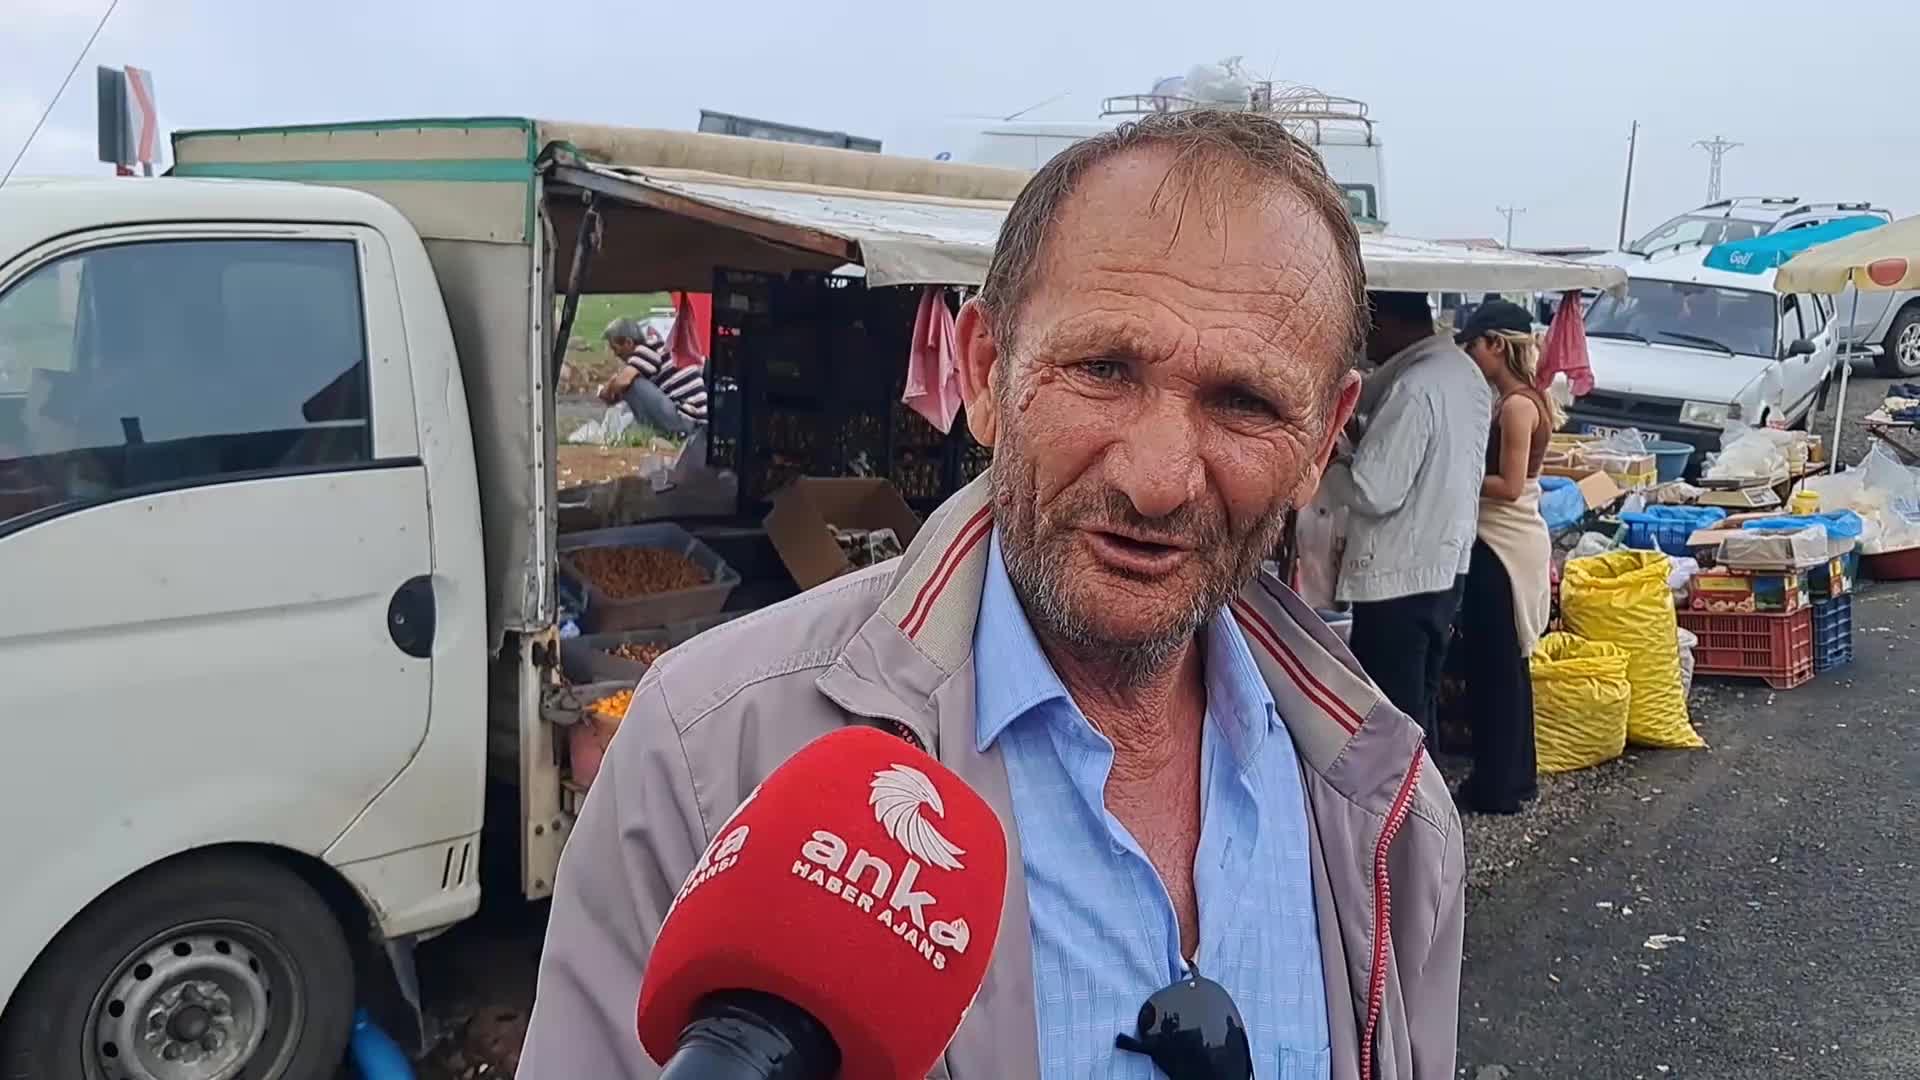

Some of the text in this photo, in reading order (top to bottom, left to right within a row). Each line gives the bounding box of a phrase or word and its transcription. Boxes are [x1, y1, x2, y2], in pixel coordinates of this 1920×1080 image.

[1730, 250, 1753, 265] Golf
[791, 860, 947, 970] HABER AJANS
[801, 830, 970, 954] anka
